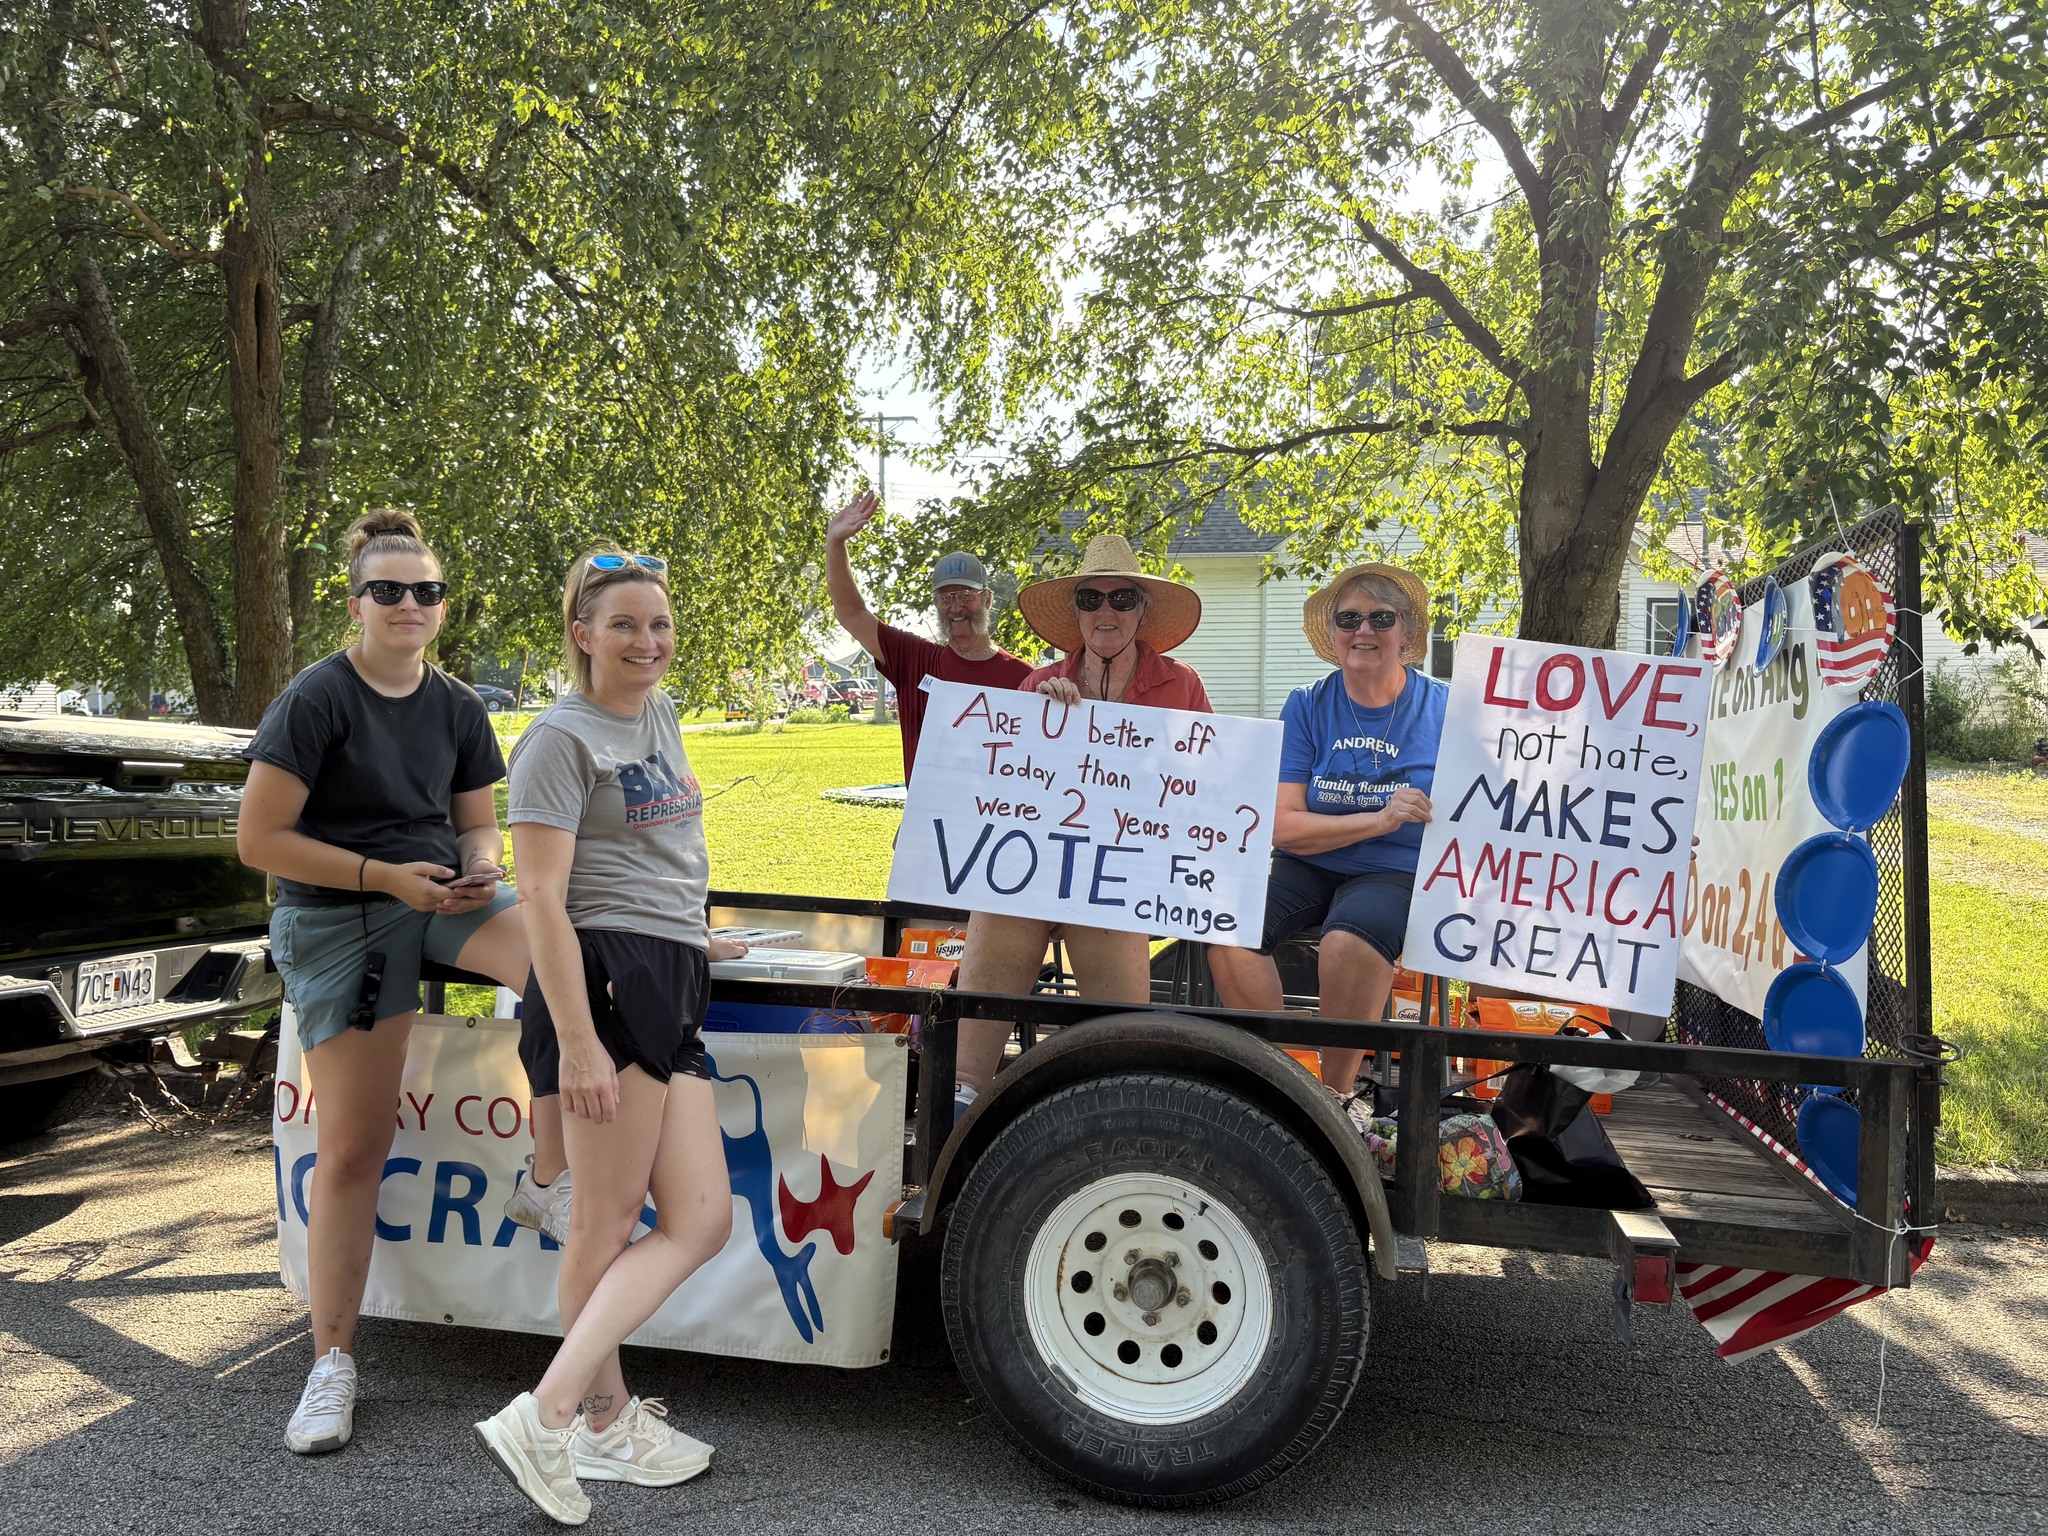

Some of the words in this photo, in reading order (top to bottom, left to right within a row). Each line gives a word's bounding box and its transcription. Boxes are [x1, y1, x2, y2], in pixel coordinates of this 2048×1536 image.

[1483, 646, 1703, 738] LOVE,
[1732, 665, 1756, 716] on
[1760, 642, 1810, 721] Aug
[951, 691, 1022, 736] ARE
[1041, 699, 1070, 740] U
[1088, 704, 1155, 750] better
[1174, 721, 1216, 756] off
[1331, 736, 1400, 759] ANDREW
[982, 741, 1056, 791] Today
[1077, 753, 1131, 791] than
[1158, 773, 1197, 808] you
[1496, 724, 1567, 765] not
[1579, 725, 1688, 780] hate,
[625, 796, 702, 824] REPRESENTA
[1312, 775, 1355, 795] Family
[1317, 791, 1342, 804] 2024
[1710, 760, 1738, 822] YES
[1742, 774, 1768, 822] on
[1773, 757, 1784, 821] 1
[0, 816, 239, 843] CHEVROLE
[975, 795, 1041, 821] were
[1058, 787, 1090, 829] 2
[1113, 808, 1170, 846] years
[1448, 773, 1685, 855] MAKES
[932, 818, 1144, 907] VOTE
[1422, 837, 1677, 939] AMERICA
[1134, 894, 1238, 935] change
[1701, 883, 1732, 950] on
[936, 944, 965, 957] ldfish
[1433, 912, 1661, 994] GREAT
[80, 972, 114, 1005] 7CE
[121, 967, 152, 1000] N43
[1397, 1009, 1420, 1021] Goldfis
[1082, 1136, 1215, 1175] RADIAL
[1061, 1420, 1217, 1468] TRAILER
